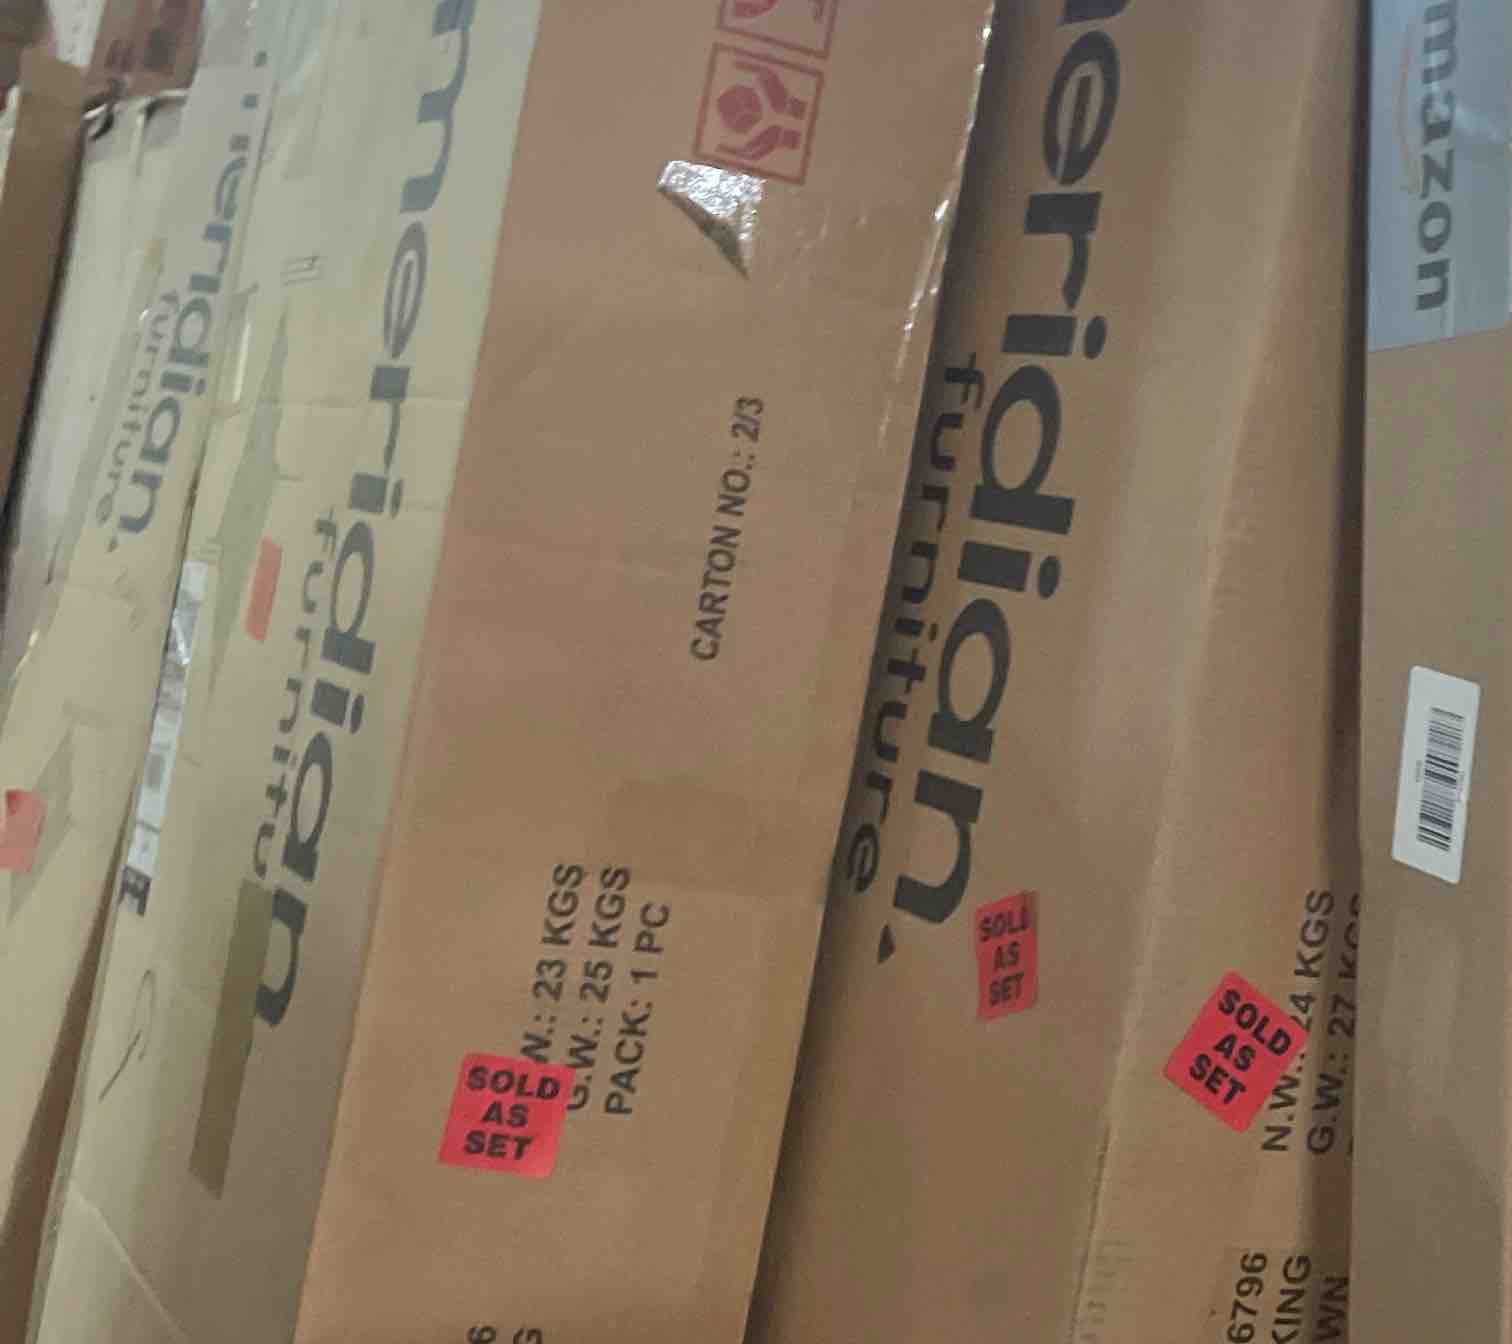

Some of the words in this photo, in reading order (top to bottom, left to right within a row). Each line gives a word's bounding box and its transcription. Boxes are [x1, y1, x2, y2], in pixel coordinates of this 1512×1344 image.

[730, 396, 764, 443] 2/3
[715, 449, 756, 517] NO.:
[690, 525, 743, 660] CARTON
[845, 350, 985, 895] furniture
[252, 506, 338, 881] furnitu
[540, 863, 585, 946] KGS
[587, 865, 631, 949] KGS
[633, 902, 671, 955] PC
[993, 941, 1020, 971] AS
[1293, 889, 1335, 979] KGS
[531, 958, 568, 1002] 23
[578, 959, 614, 1004] 25
[629, 970, 659, 985] 1
[989, 972, 1025, 1008] SET
[1218, 988, 1293, 1057] SOLD
[1327, 993, 1357, 1039] 27
[604, 999, 653, 1116] PACK:
[1211, 1032, 1257, 1072] AS
[466, 1065, 562, 1100] SOLD
[1188, 1053, 1248, 1106] SET
[1306, 1053, 1349, 1155] G.W.:
[480, 1100, 530, 1128] AS
[464, 1130, 534, 1161] SET
